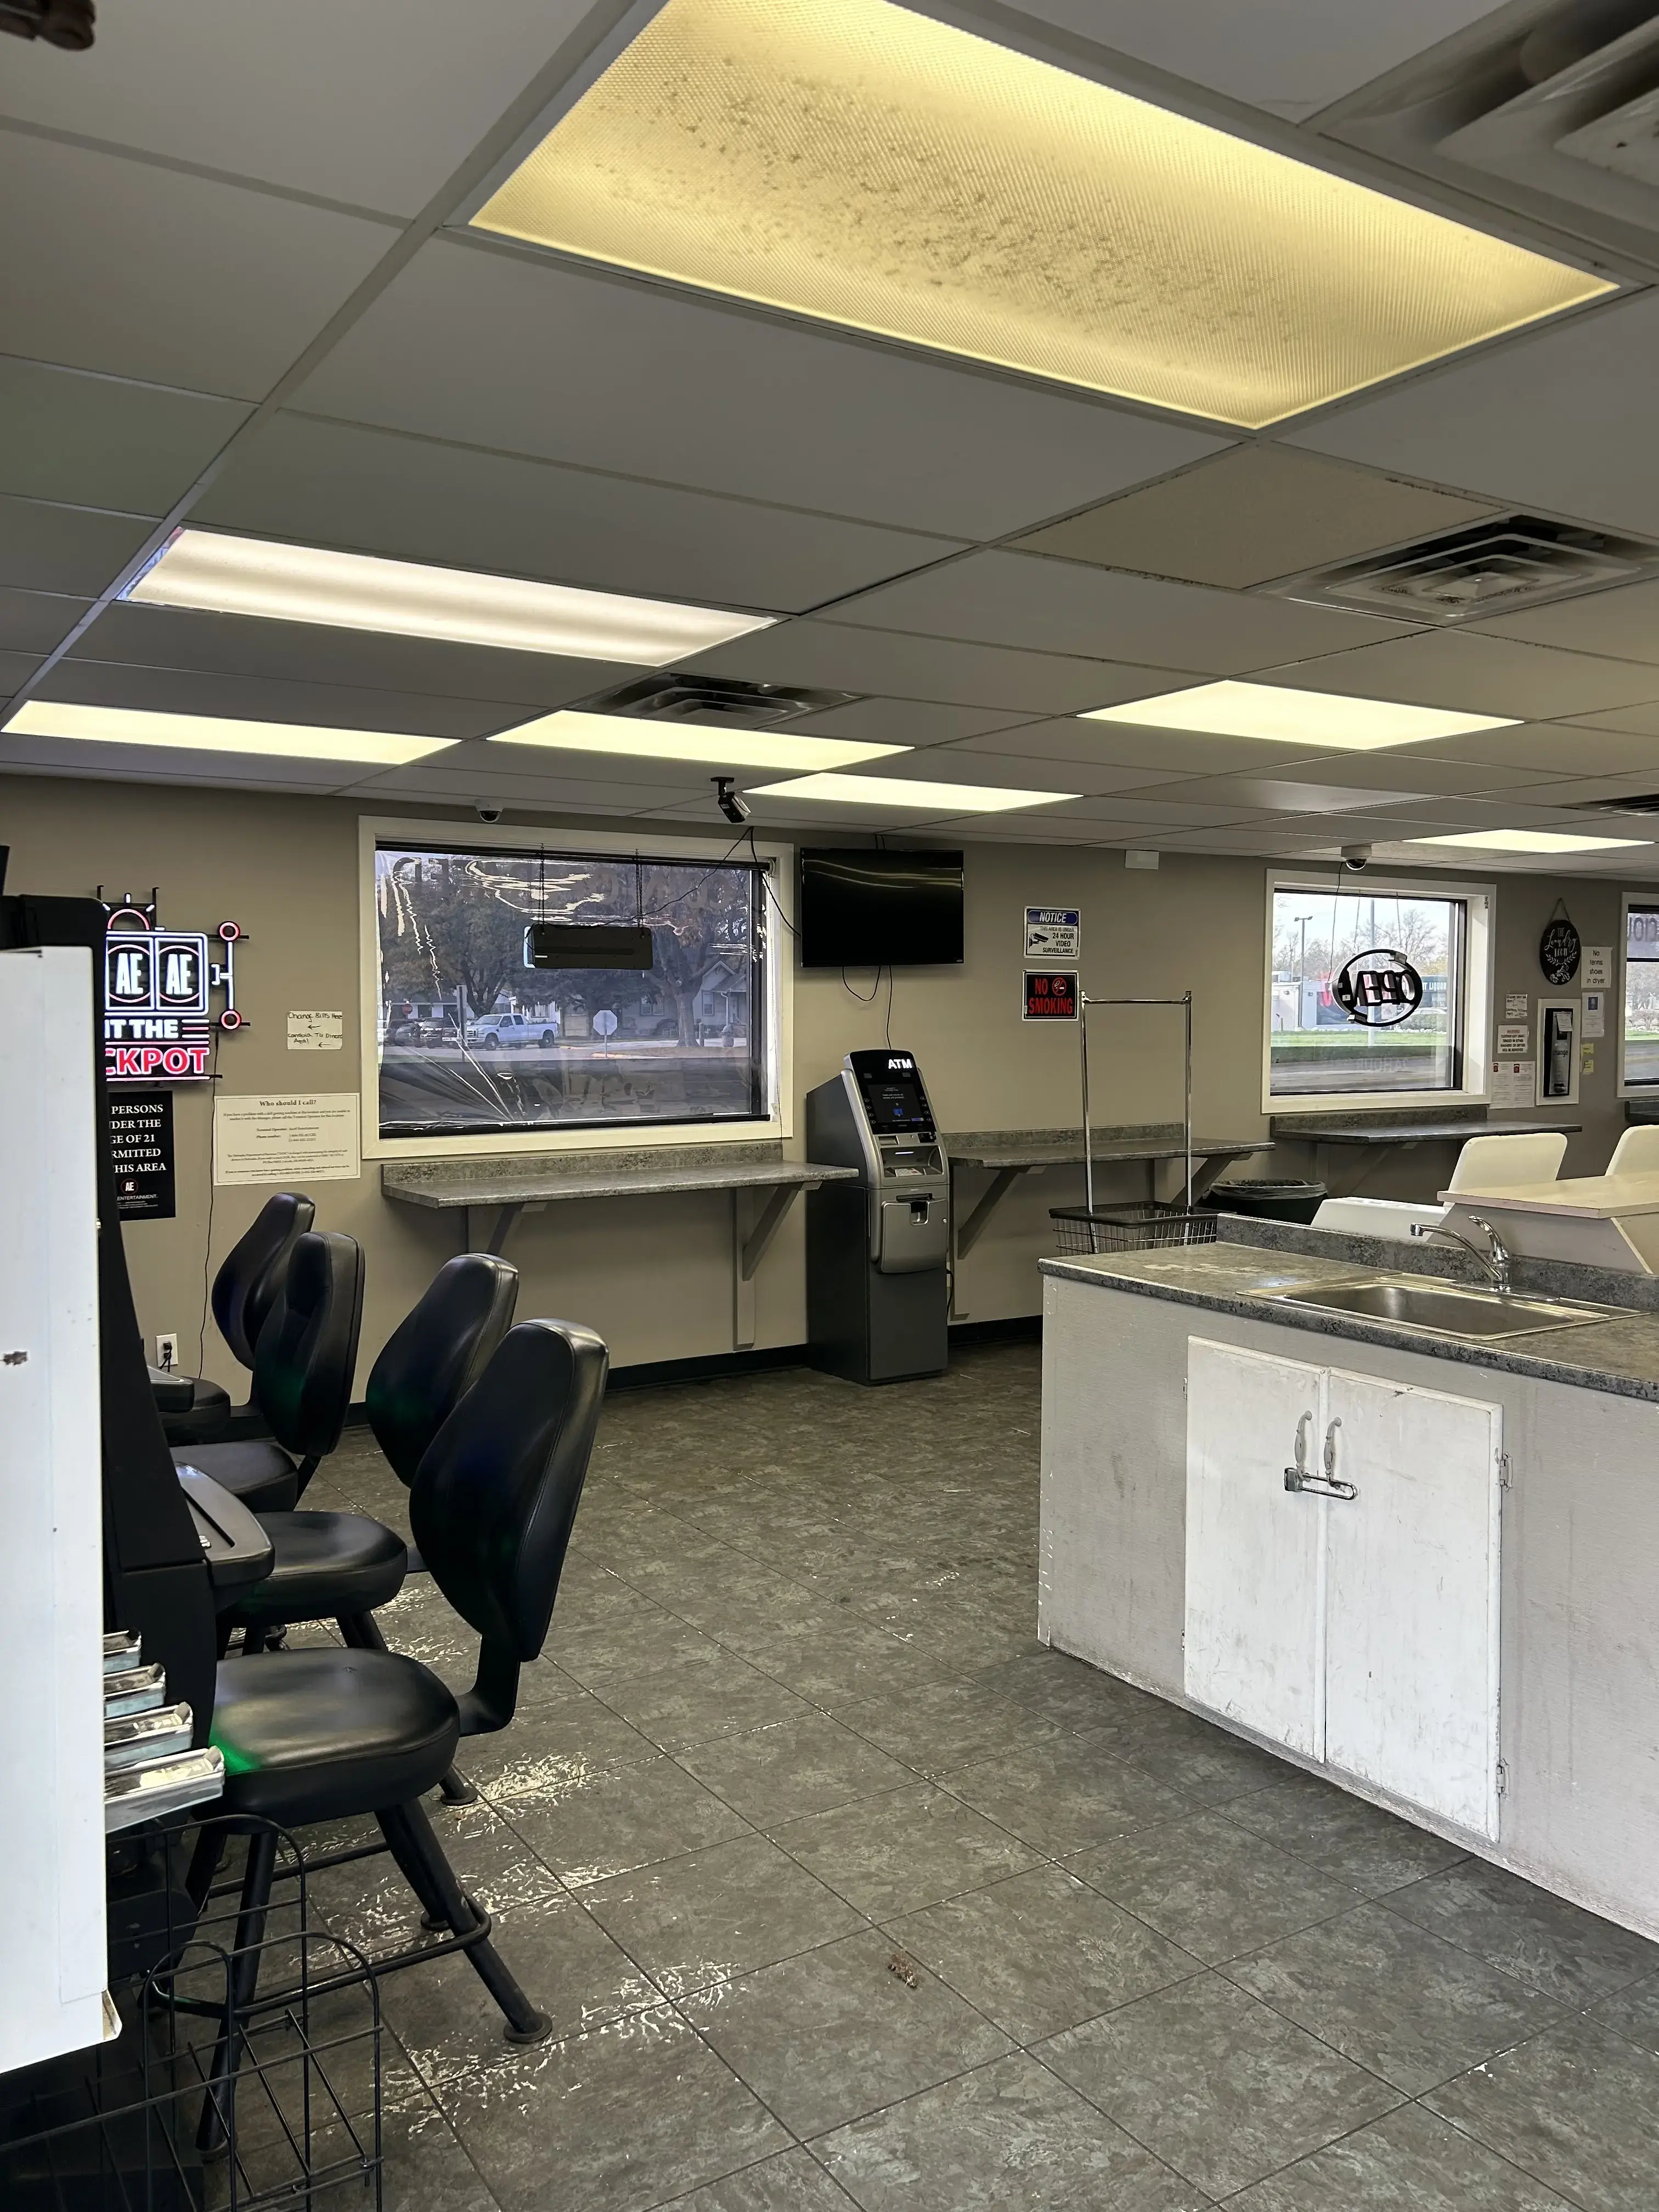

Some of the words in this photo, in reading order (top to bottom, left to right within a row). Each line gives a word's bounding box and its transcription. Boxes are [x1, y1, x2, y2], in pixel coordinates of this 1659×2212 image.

[1039, 912, 1067, 923] NOTICE
[115, 953, 144, 995] AE
[166, 953, 193, 995] AE
[1035, 978, 1048, 995] NO
[1029, 997, 1073, 1014] SMOKING
[288, 1012, 314, 1023] Change
[129, 1019, 179, 1039] THE
[888, 1059, 913, 1069] ATM
[111, 1104, 163, 1114] PERSONS
[109, 1120, 136, 1129] DER
[137, 1119, 161, 1128] THE
[126, 1135, 142, 1143] OF
[143, 1134, 155, 1142] 21
[113, 1164, 134, 1173] HIS
[136, 1163, 167, 1172] AREA
